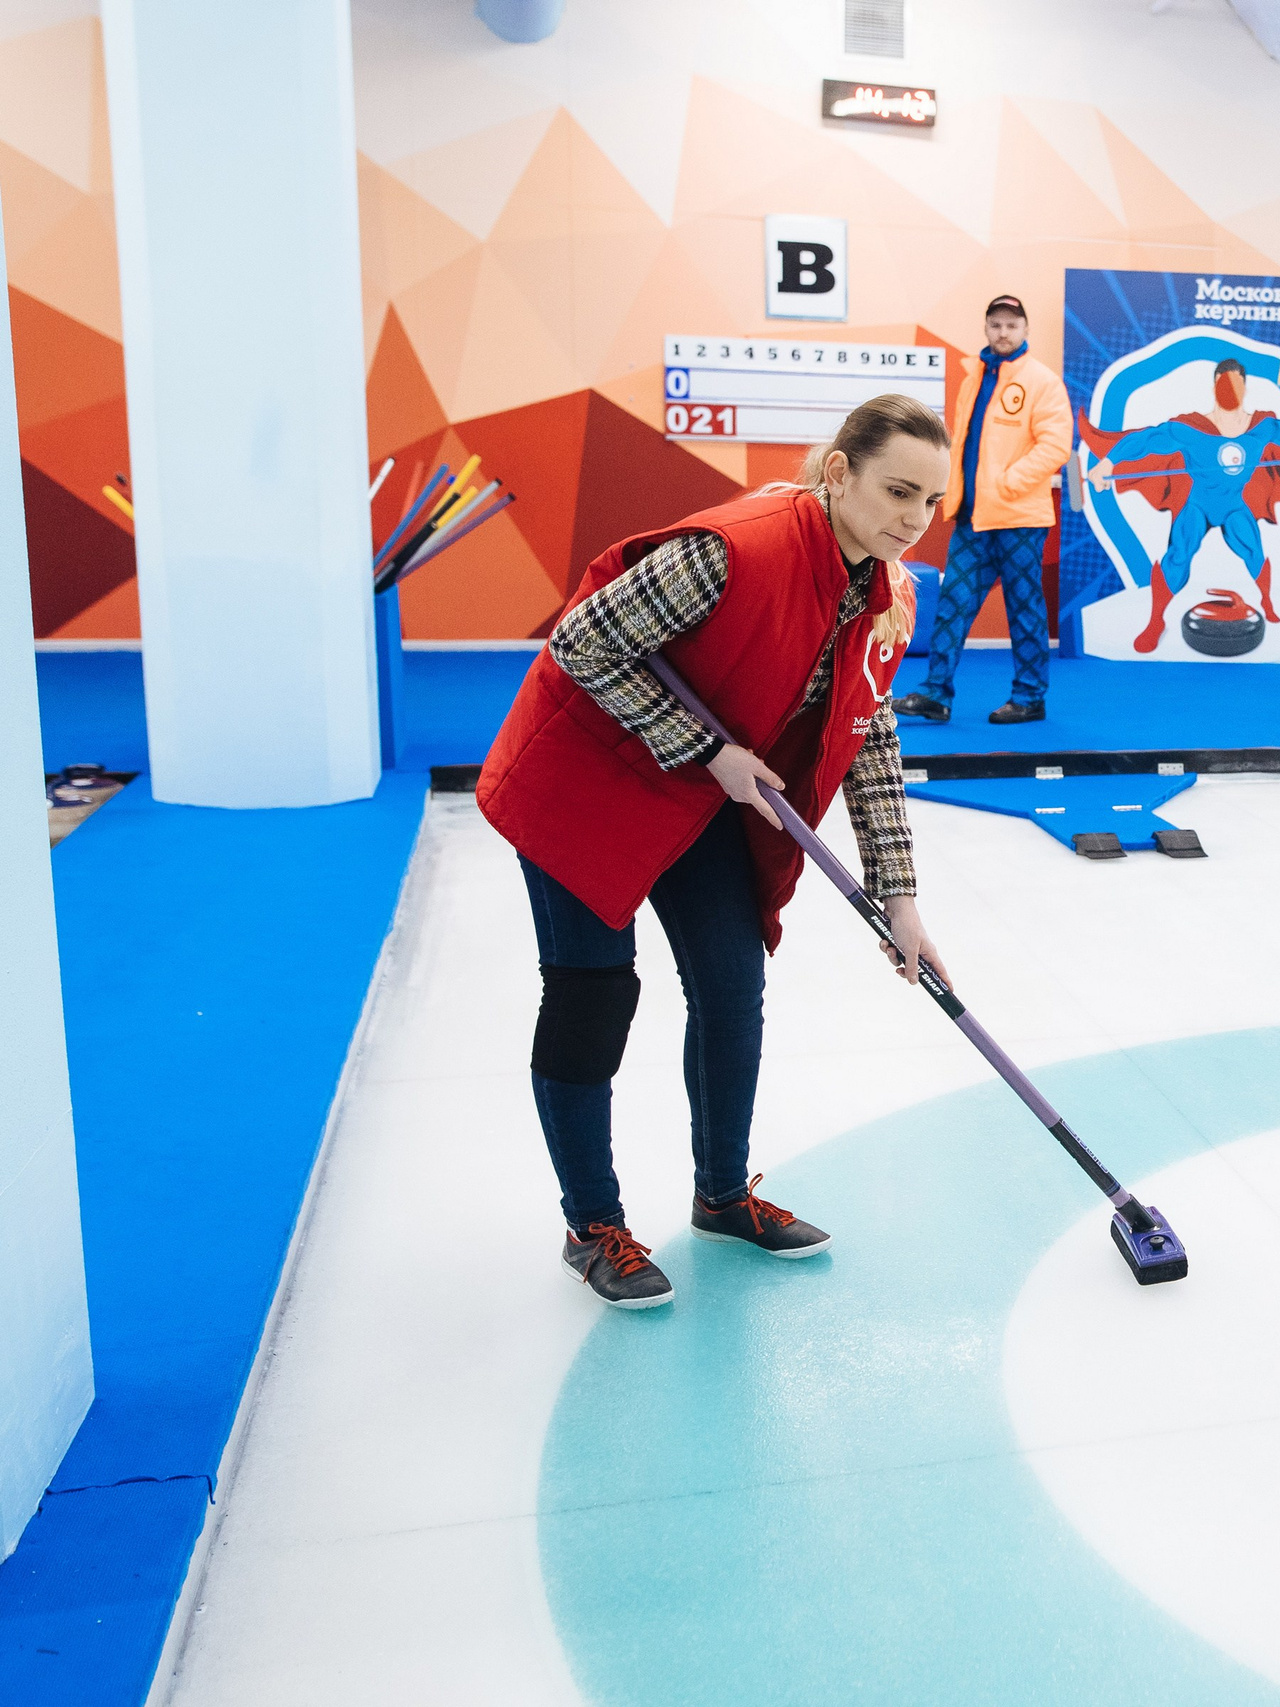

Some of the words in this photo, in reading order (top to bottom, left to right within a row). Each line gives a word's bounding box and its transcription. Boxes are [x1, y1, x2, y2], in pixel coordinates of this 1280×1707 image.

[777, 241, 836, 294] B
[696, 344, 707, 358] 2
[720, 345, 731, 359] 3
[744, 346, 755, 360] 4
[768, 347, 778, 361] 5
[790, 348, 802, 362] 6
[814, 349, 825, 363] 7
[837, 350, 848, 364] 8
[860, 351, 871, 365] 9
[880, 352, 898, 366] 10
[905, 353, 917, 367] E
[927, 354, 940, 368] E
[666, 370, 689, 398] 0
[921, 973, 944, 996] SHAFT
